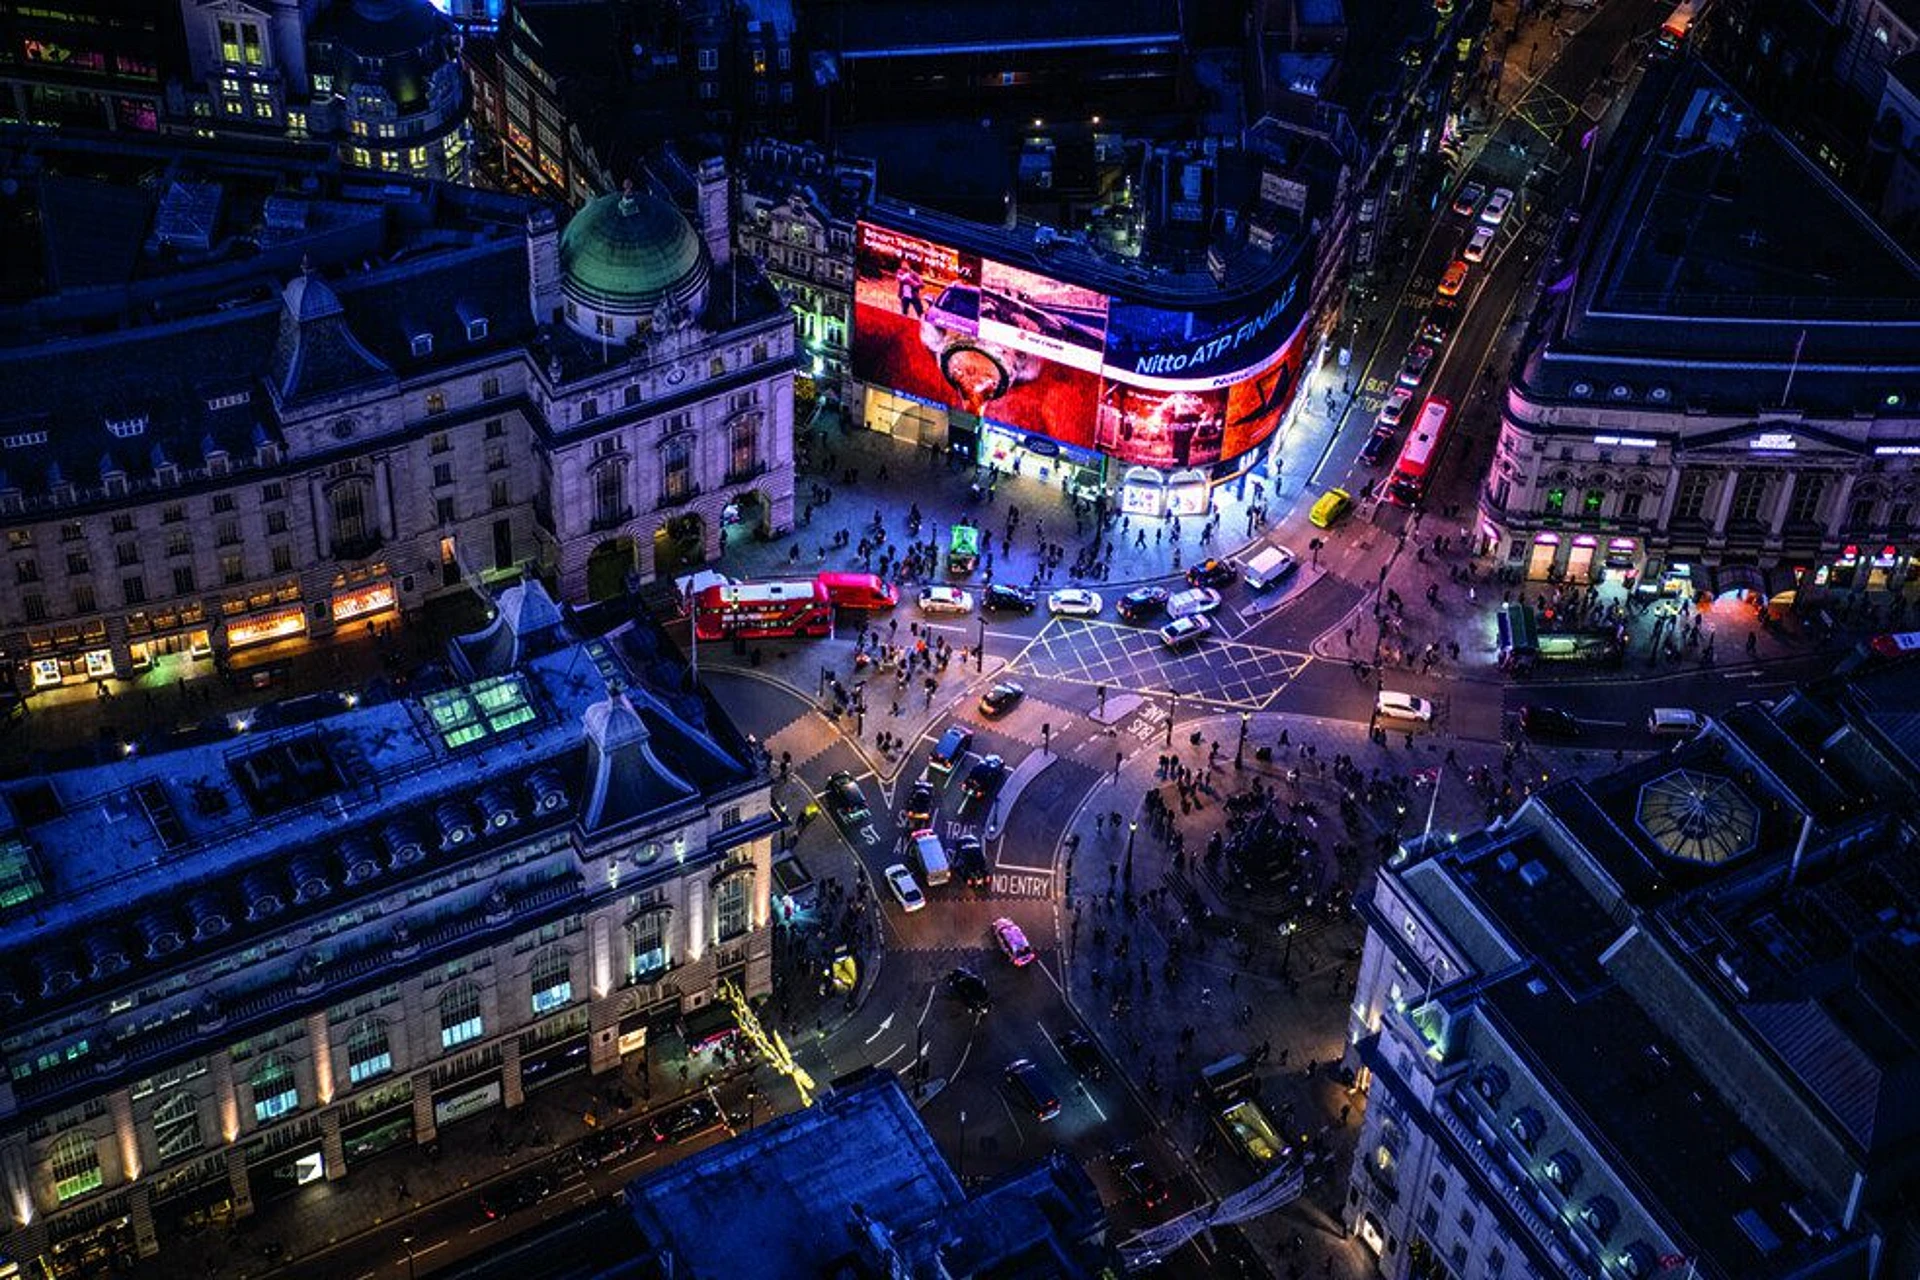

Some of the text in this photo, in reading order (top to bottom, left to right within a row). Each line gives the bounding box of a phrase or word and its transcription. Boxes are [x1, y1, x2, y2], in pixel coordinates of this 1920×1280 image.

[1135, 354, 1187, 375] Nitto
[1188, 334, 1232, 368] ATP
[1233, 274, 1299, 348] FINALS
[859, 823, 881, 846] ST
[991, 874, 1050, 897] NO ENTRY
